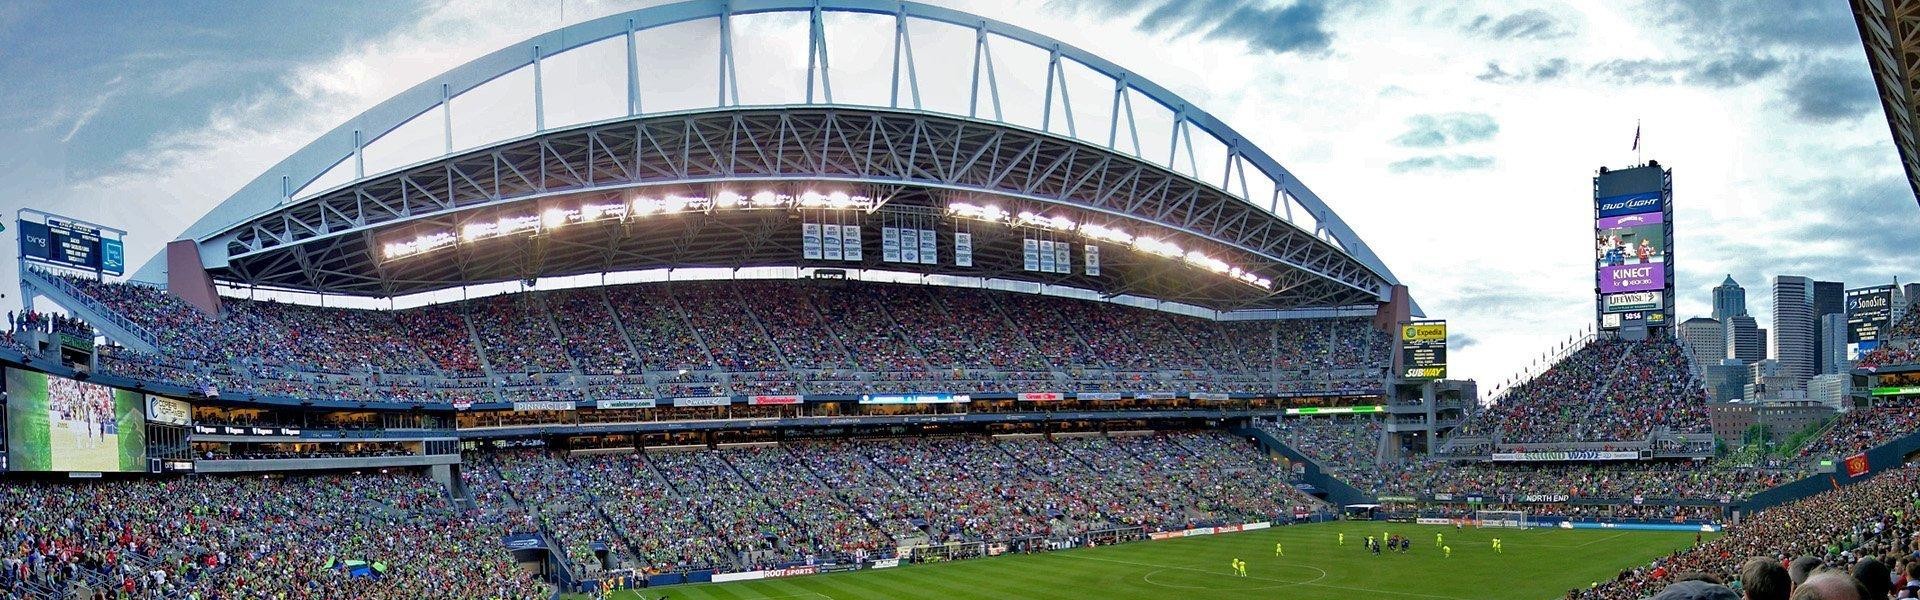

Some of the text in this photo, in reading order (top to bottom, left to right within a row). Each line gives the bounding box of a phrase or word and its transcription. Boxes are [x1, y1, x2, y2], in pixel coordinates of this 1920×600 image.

[1602, 199, 1658, 210] BUD LIGHT
[26, 234, 46, 248] bing
[1613, 267, 1653, 280] KINECT
[1858, 296, 1886, 309] SonoSite
[1417, 329, 1442, 337] Expedia
[1405, 367, 1445, 378] SUBWAY
[519, 402, 565, 411] PINNACLE
[1553, 494, 1569, 502] END
[765, 568, 814, 578] ROOT SPORTS
